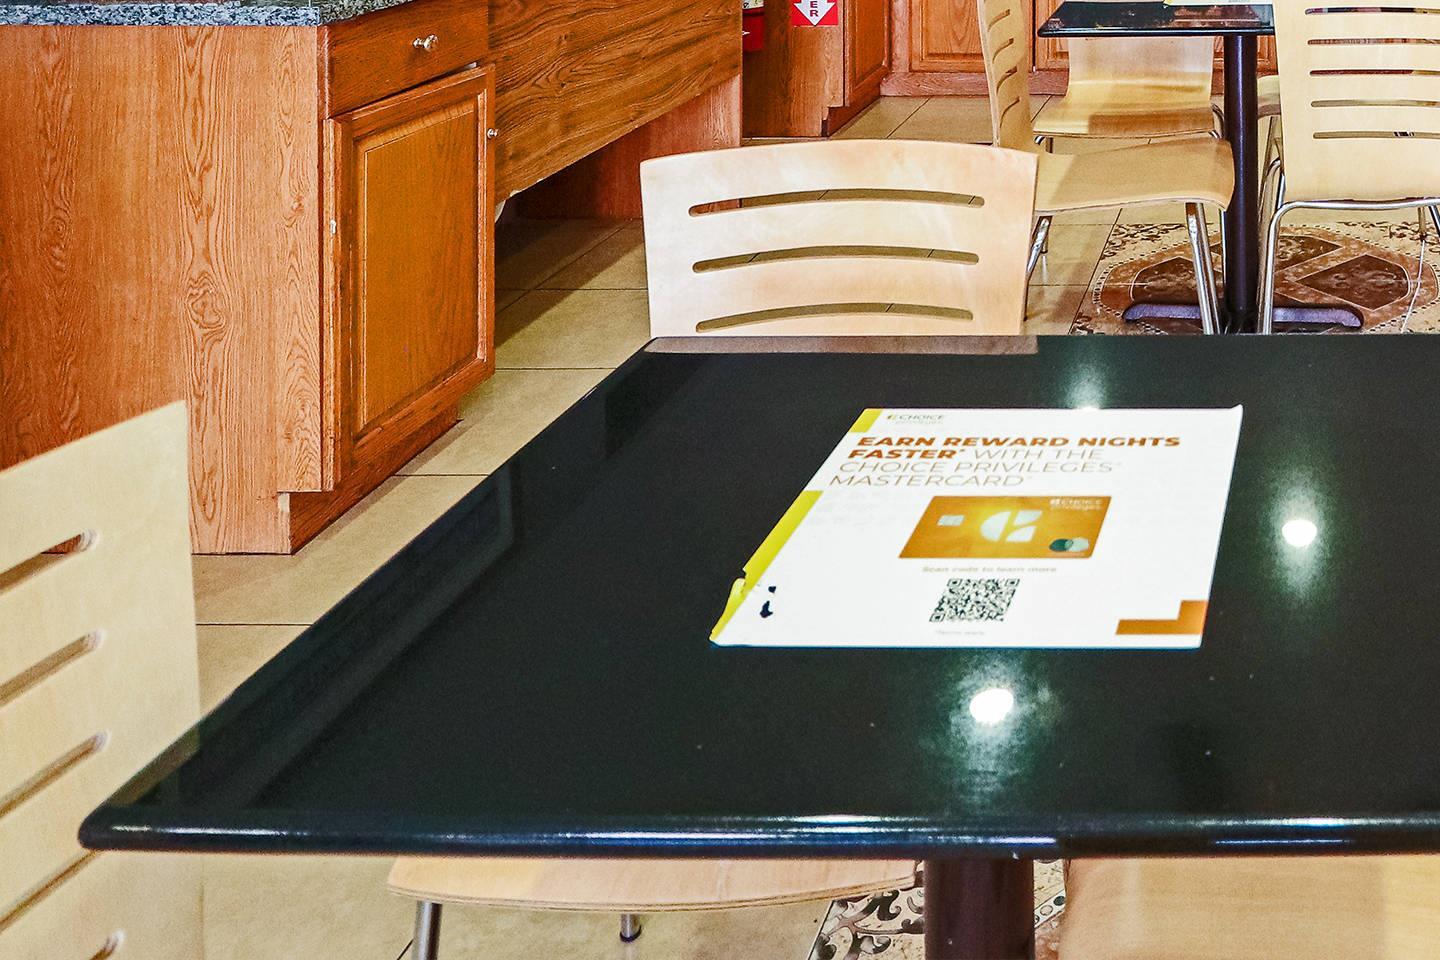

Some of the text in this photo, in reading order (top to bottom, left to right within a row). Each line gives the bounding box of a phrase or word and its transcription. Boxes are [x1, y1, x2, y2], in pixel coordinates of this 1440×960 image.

[857, 437, 1182, 447] EARN REWARD NIGHTS
[973, 449, 1044, 460] WITH
[1054, 449, 1105, 460] THE
[839, 461, 946, 473] CHOICE
